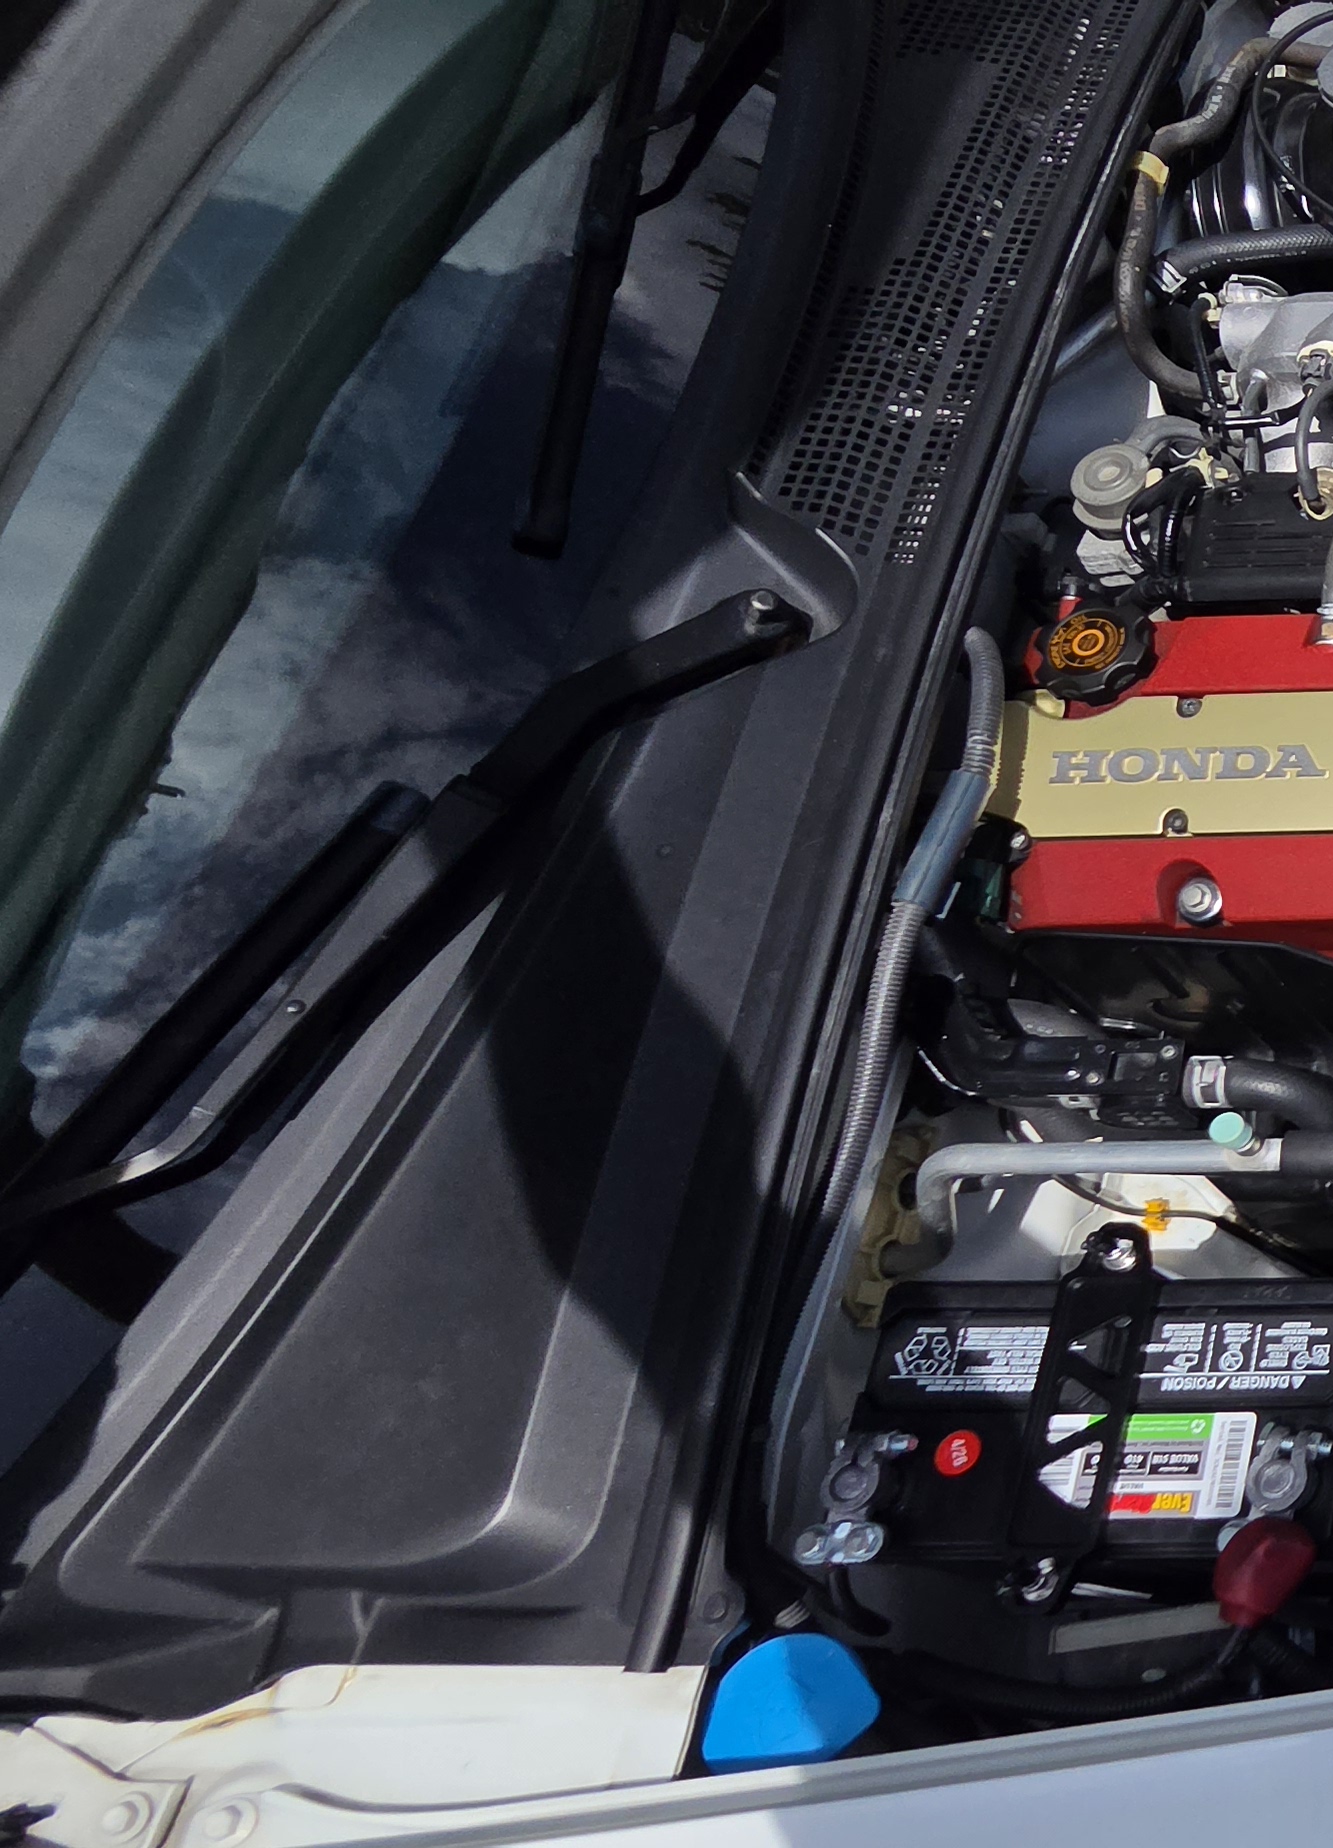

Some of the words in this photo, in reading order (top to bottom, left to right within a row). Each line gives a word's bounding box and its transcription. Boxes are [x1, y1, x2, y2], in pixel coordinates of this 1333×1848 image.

[1049, 743, 1328, 786] HONDA
[1160, 1376, 1217, 1392] POISON
[1228, 1375, 1290, 1389] DANGER
